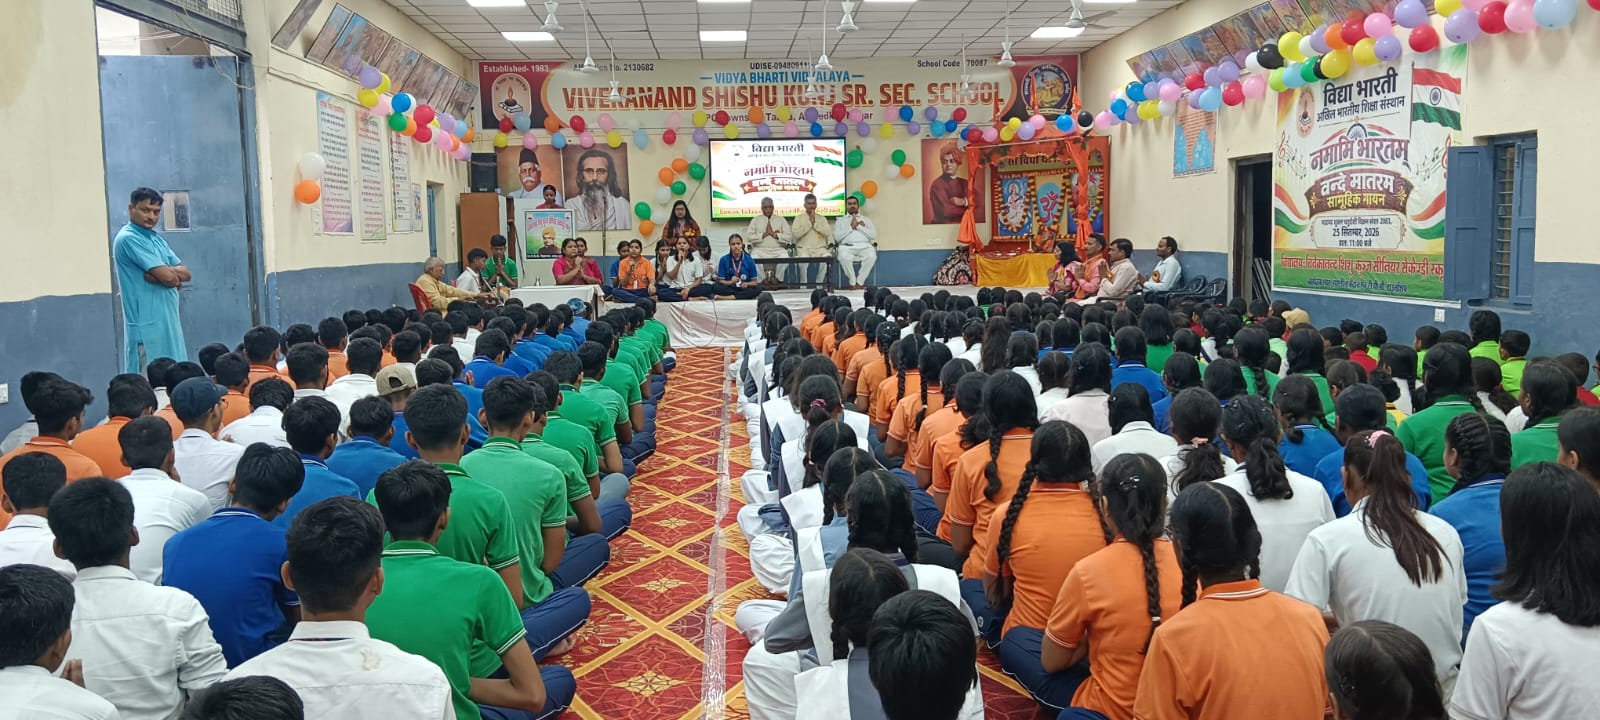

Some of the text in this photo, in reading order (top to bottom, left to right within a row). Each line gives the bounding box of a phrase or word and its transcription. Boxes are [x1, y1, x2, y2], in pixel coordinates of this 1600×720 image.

[917, 59, 940, 68] School
[714, 72, 747, 85] VIDYA
[749, 71, 788, 84] BHARTI
[1323, 82, 1353, 107] विद्या
[1356, 66, 1398, 98] भारती
[562, 85, 697, 111] VIVEKANAND
[702, 84, 778, 110] SHISHU
[841, 83, 875, 107] SR.
[879, 82, 921, 107] SEC.
[927, 81, 1005, 106] SCHOOL
[1337, 102, 1360, 117] भारतीय
[1361, 99, 1378, 113] शिक्षा
[1379, 95, 1406, 110] संस्थान
[1309, 136, 1355, 171] नमामि
[1320, 171, 1347, 196] वन्दे
[1364, 227, 1379, 237] 2026
